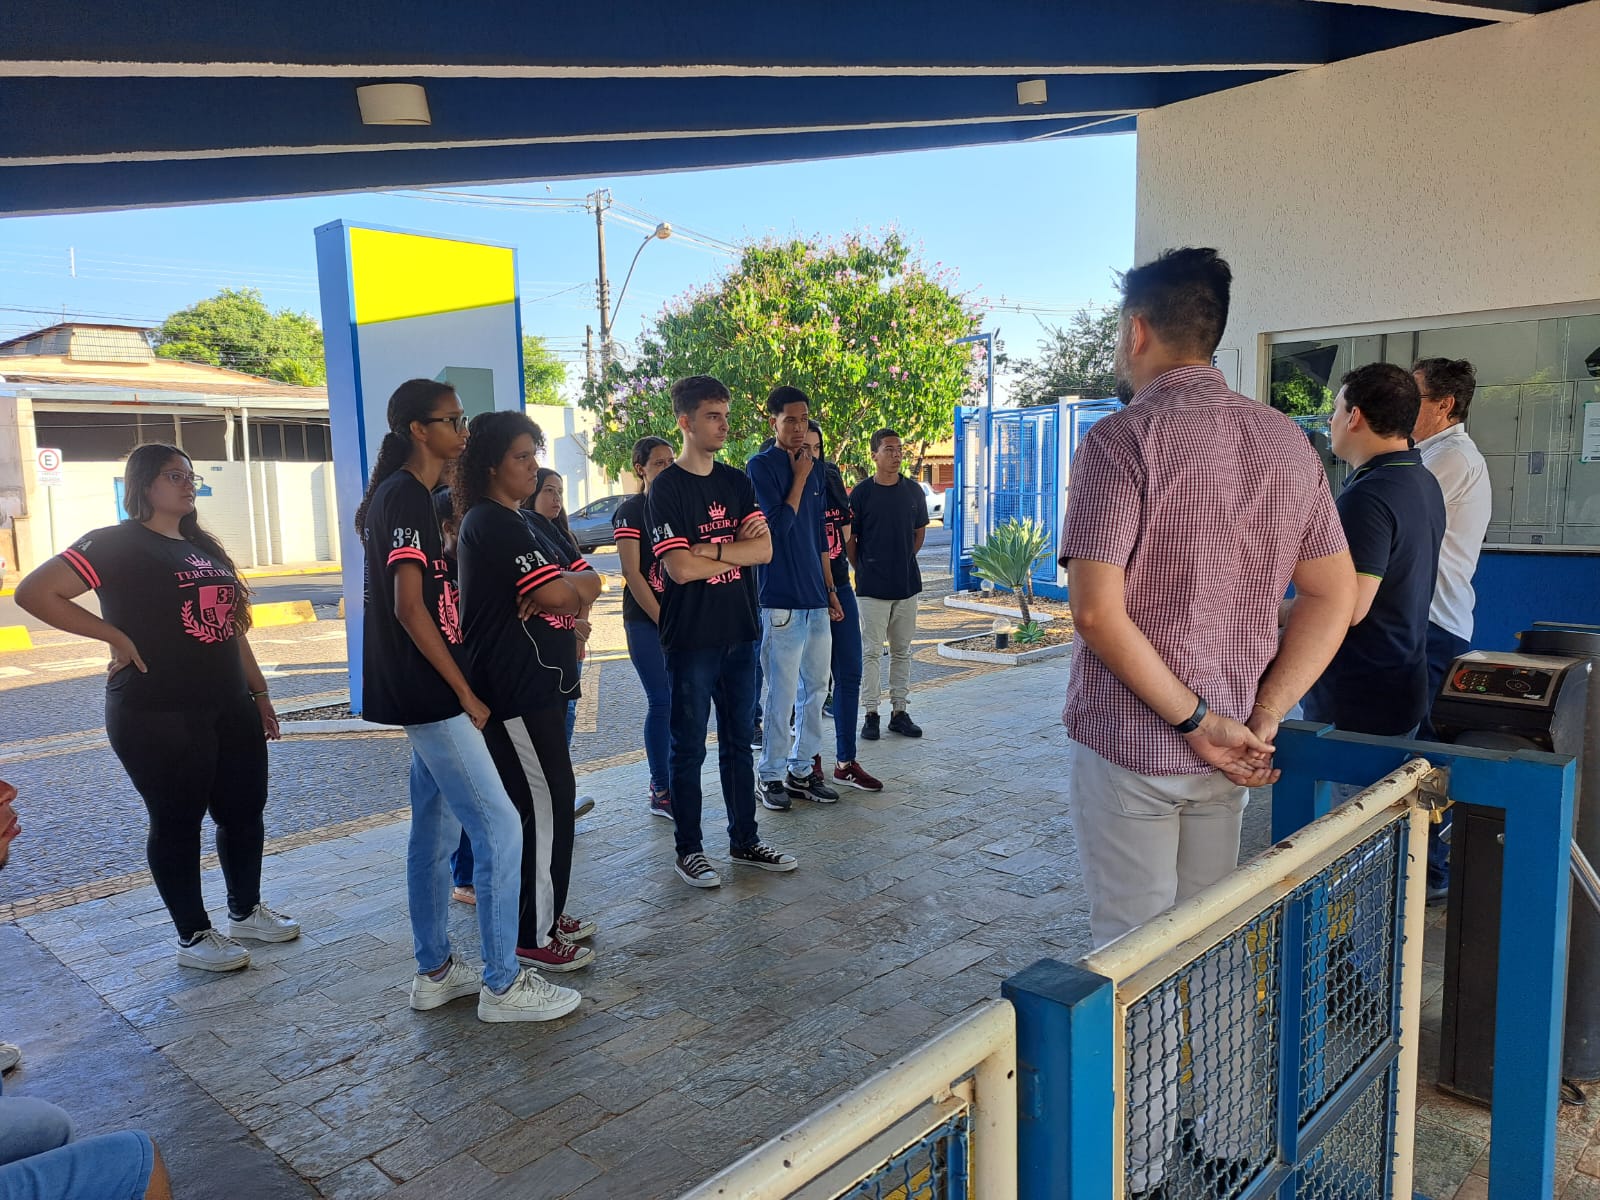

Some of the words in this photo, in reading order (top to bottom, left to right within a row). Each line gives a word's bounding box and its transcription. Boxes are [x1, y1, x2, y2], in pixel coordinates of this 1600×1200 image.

[44, 454, 52, 466] E
[392, 527, 422, 550] 3ºA
[515, 550, 550, 573] 3ºA
